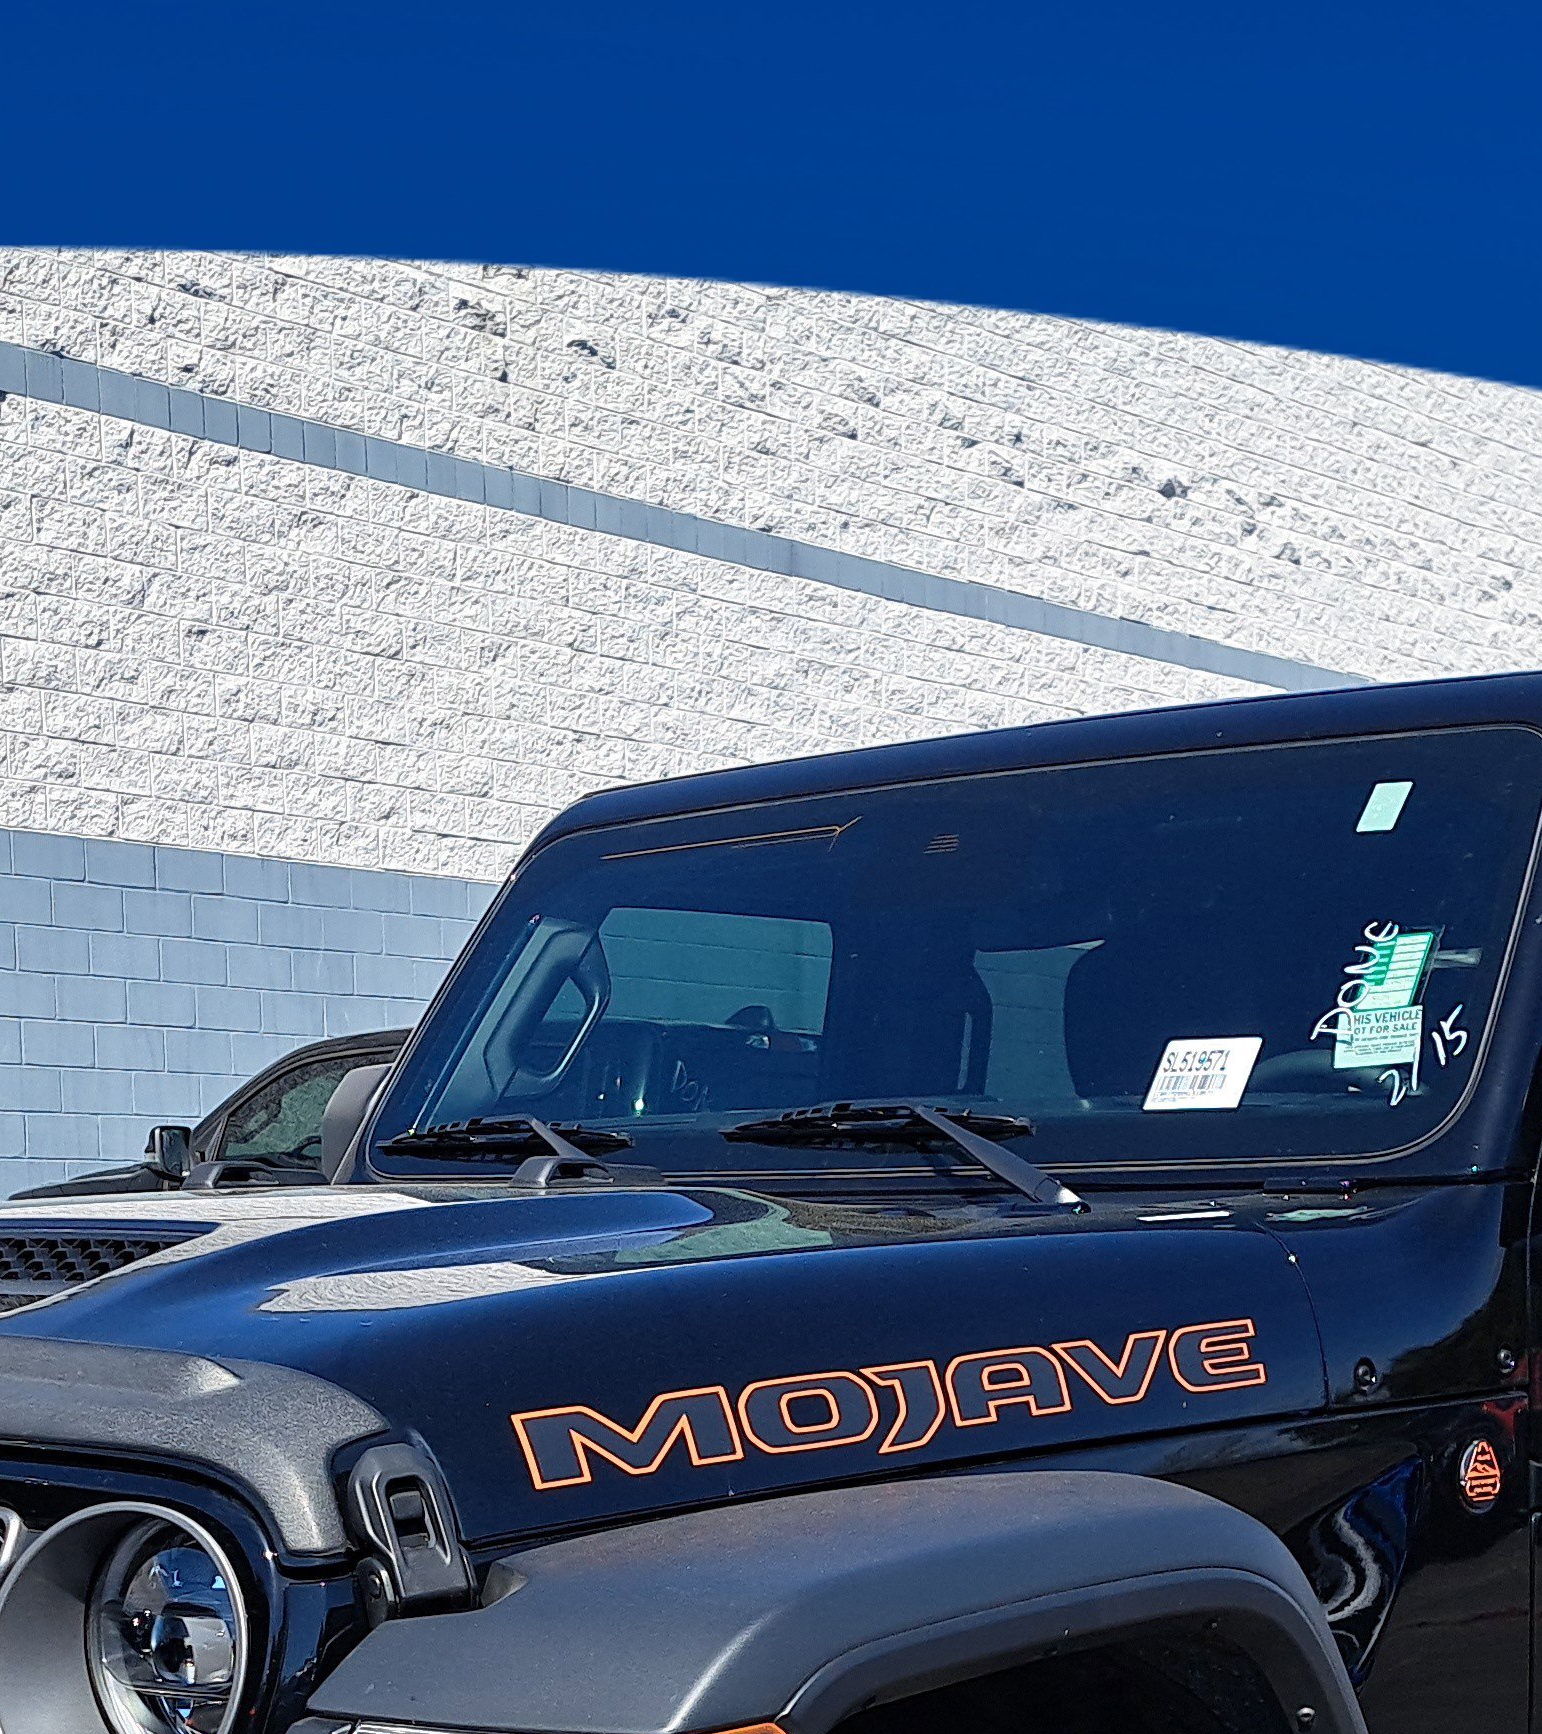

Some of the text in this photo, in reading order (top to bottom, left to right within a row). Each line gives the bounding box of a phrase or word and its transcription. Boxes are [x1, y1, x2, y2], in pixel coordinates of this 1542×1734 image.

[1352, 1009, 1422, 1026] HIS VEHICLE
[1369, 1024, 1390, 1035] FOR
[1392, 1021, 1418, 1033] SALE
[511, 1318, 1267, 1490] MOJAVE
